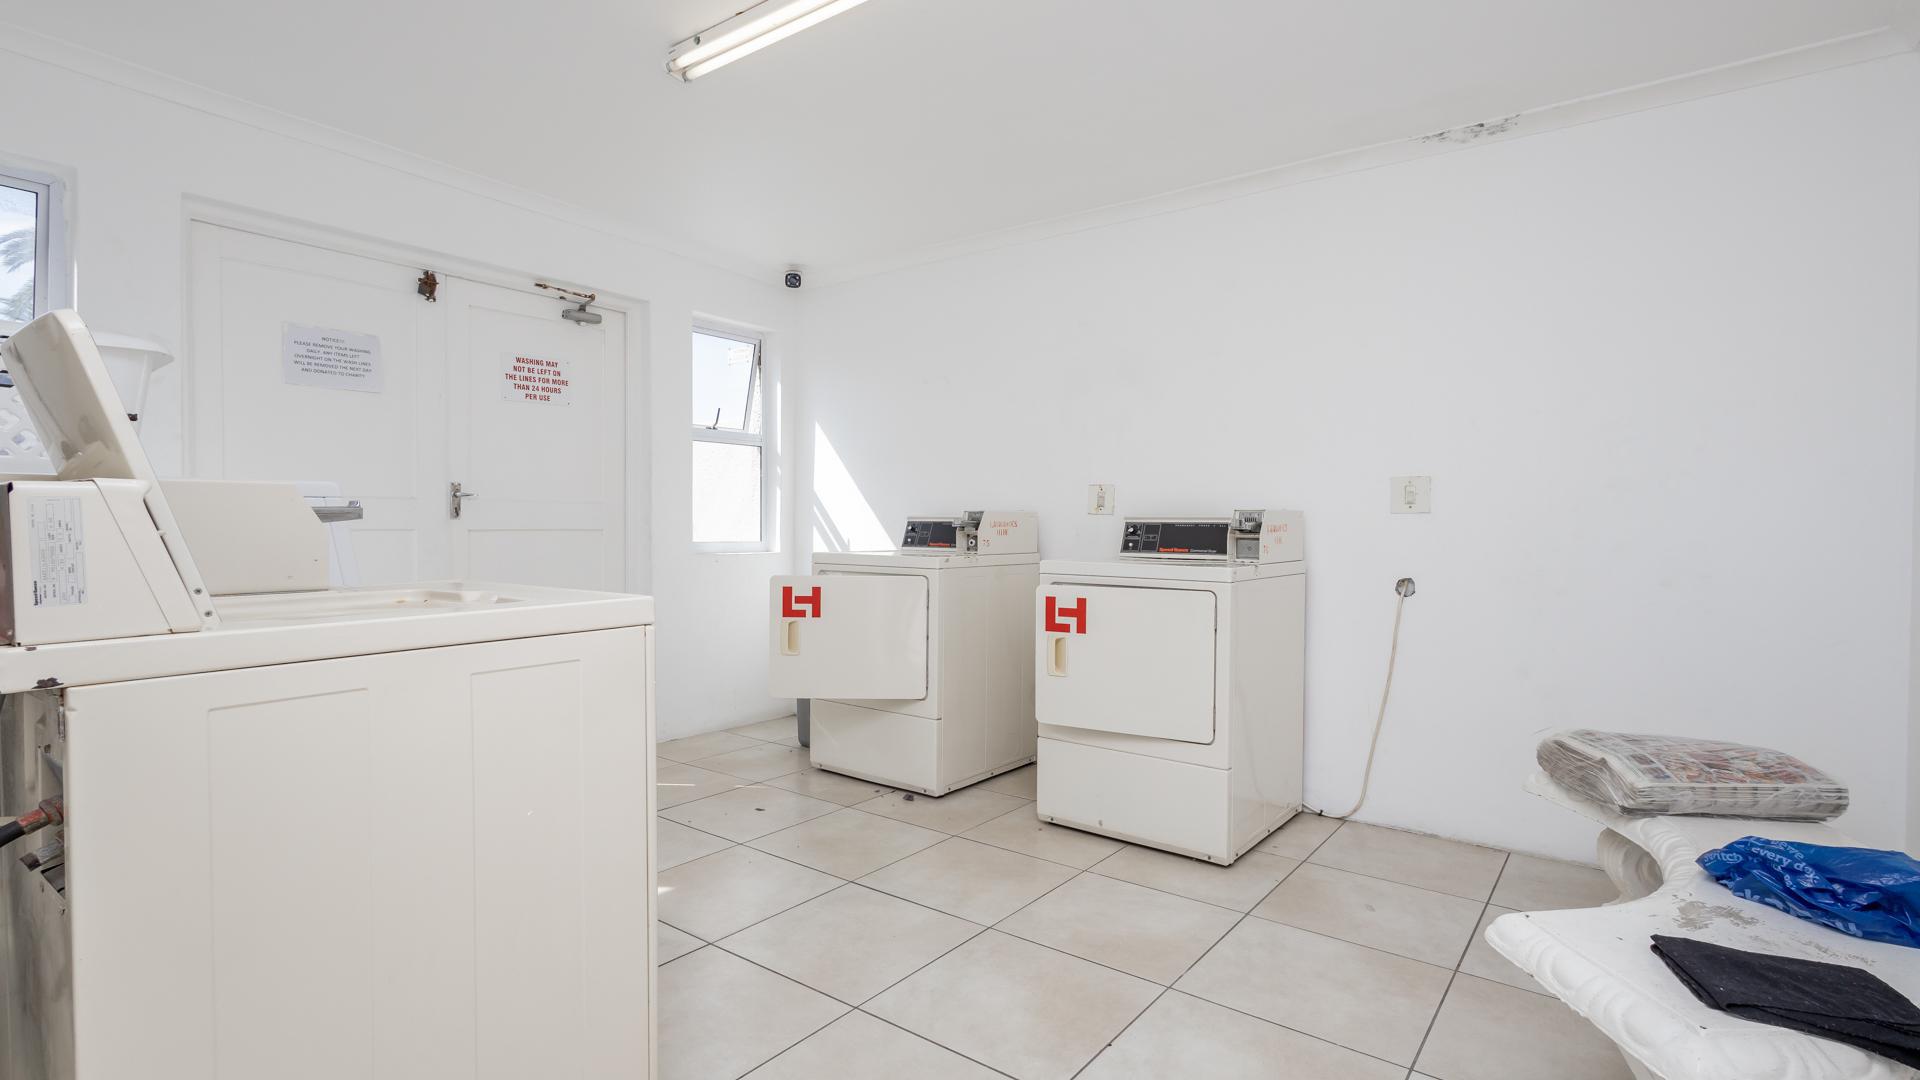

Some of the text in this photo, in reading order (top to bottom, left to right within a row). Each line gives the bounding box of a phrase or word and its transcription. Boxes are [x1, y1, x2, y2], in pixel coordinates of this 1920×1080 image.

[294, 353, 323, 361] OVERNIGHT
[515, 356, 558, 368] WASHING MAY
[314, 362, 338, 370] REMOVED
[513, 365, 525, 373] NOT
[537, 368, 551, 376] LEFT
[312, 368, 337, 376] DONATED
[518, 374, 537, 383] LINES
[551, 378, 569, 387] MORE
[513, 383, 530, 391] THAN
[541, 386, 562, 394] HOURS
[525, 393, 551, 402] PER USE
[1751, 847, 1792, 867] every
